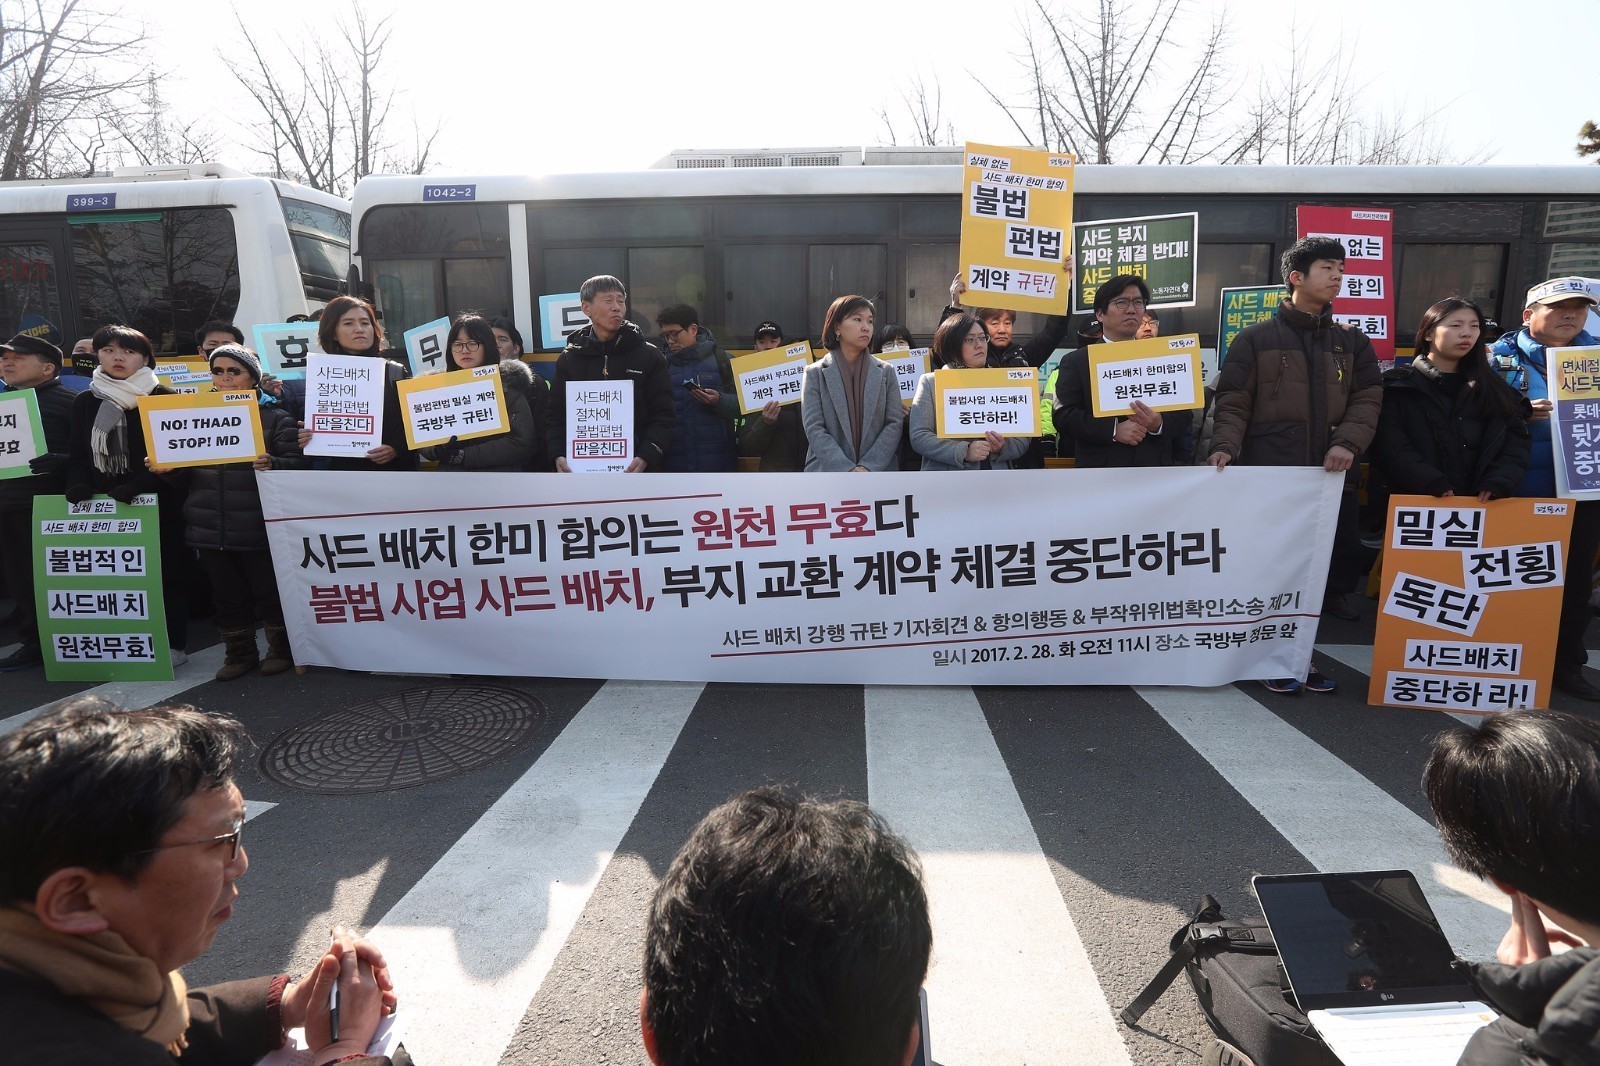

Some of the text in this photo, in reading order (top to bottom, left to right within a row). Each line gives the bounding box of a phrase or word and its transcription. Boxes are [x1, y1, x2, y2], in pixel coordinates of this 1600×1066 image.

[970, 156, 1009, 170] 실체 없는
[984, 172, 1065, 190] 사드 배치 한미 합의
[73, 196, 109, 207] 399-3
[427, 188, 471, 198] 1042-2
[974, 185, 1026, 219] 불법
[1009, 227, 1061, 260] 편법
[1081, 225, 1147, 247] 사드 부지
[1081, 240, 1189, 266] 계약 체결 반대!
[1348, 238, 1381, 258] 없는
[971, 269, 1056, 294] 계약 규탄!
[1082, 267, 1112, 285] 사드
[1347, 278, 1381, 297] 합의
[1227, 293, 1258, 310] 사드
[275, 335, 309, 369] 효
[419, 334, 443, 367] 무
[317, 366, 370, 382] 사드배치
[896, 363, 916, 375] 전횡
[1102, 367, 1142, 380] 사드배치
[1145, 362, 1187, 376] 한미합의
[744, 373, 773, 386] 사드배치
[317, 383, 357, 397] 절차에
[575, 391, 623, 404] 사드배치
[752, 387, 774, 400] 계약
[1114, 381, 1177, 399] 원천무효!
[316, 400, 369, 415] 불법편법
[413, 390, 495, 413] 불법편법 밀실 계약
[948, 395, 1027, 405] 불법사업 사드배치
[0, 413, 17, 429] 지
[160, 416, 242, 431] NO! THAAD
[417, 407, 494, 432] 국방부 규탄!
[575, 408, 611, 422] 절차에
[959, 411, 1018, 425] 중단하라!
[315, 417, 371, 432] 판을친다
[575, 424, 623, 439] 불법편법
[168, 435, 240, 450] STOP! MD
[575, 442, 624, 456] 판을친다
[95, 502, 114, 513] 없는
[44, 521, 138, 533] 사드 배치 한미 합의
[300, 494, 920, 574] 사드 배치 한미 합의는 원천 무효다
[1397, 510, 1481, 548] 밀실
[49, 549, 143, 573] 불법적인
[1469, 545, 1557, 588] 전횡
[309, 528, 1227, 624] 불법 사업 사드 배치, 부지 교환 계약 체결 중단하라
[51, 592, 145, 617] 사드배치
[1393, 577, 1480, 630] 독단
[722, 591, 1300, 648] 사드 배치 강행 규탄 기자회견 & 항의행동 & 부작위위법확인소송 제기
[57, 636, 155, 660] 원천무효!
[933, 622, 1298, 667] 일시 2017. 2. 28. 화 오전 11시 장소 국방부 정문 앞
[1409, 644, 1518, 672] 사드배치
[1391, 676, 1529, 710] 중단하라!
